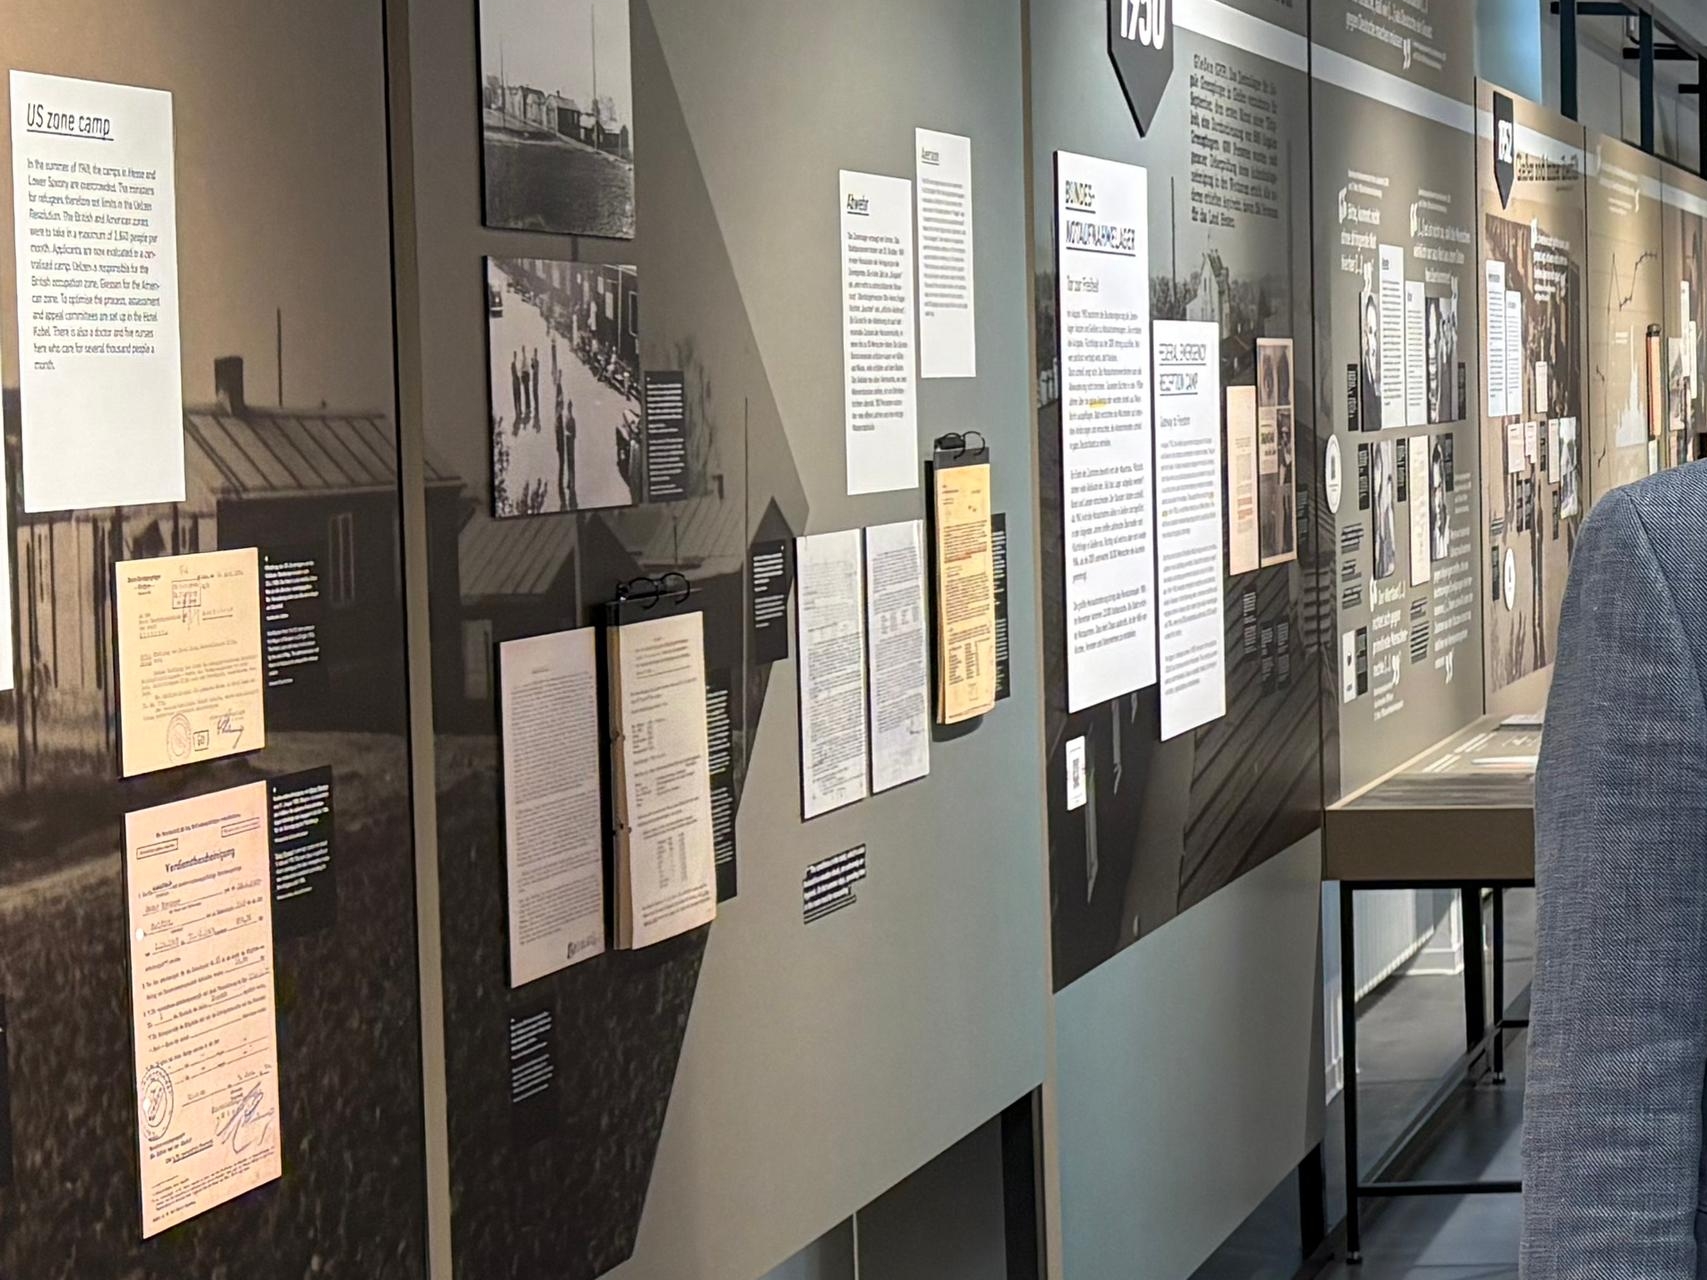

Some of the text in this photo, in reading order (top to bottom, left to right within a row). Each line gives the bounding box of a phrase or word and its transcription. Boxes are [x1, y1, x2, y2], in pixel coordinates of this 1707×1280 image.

[27, 103, 110, 138] US zone camp
